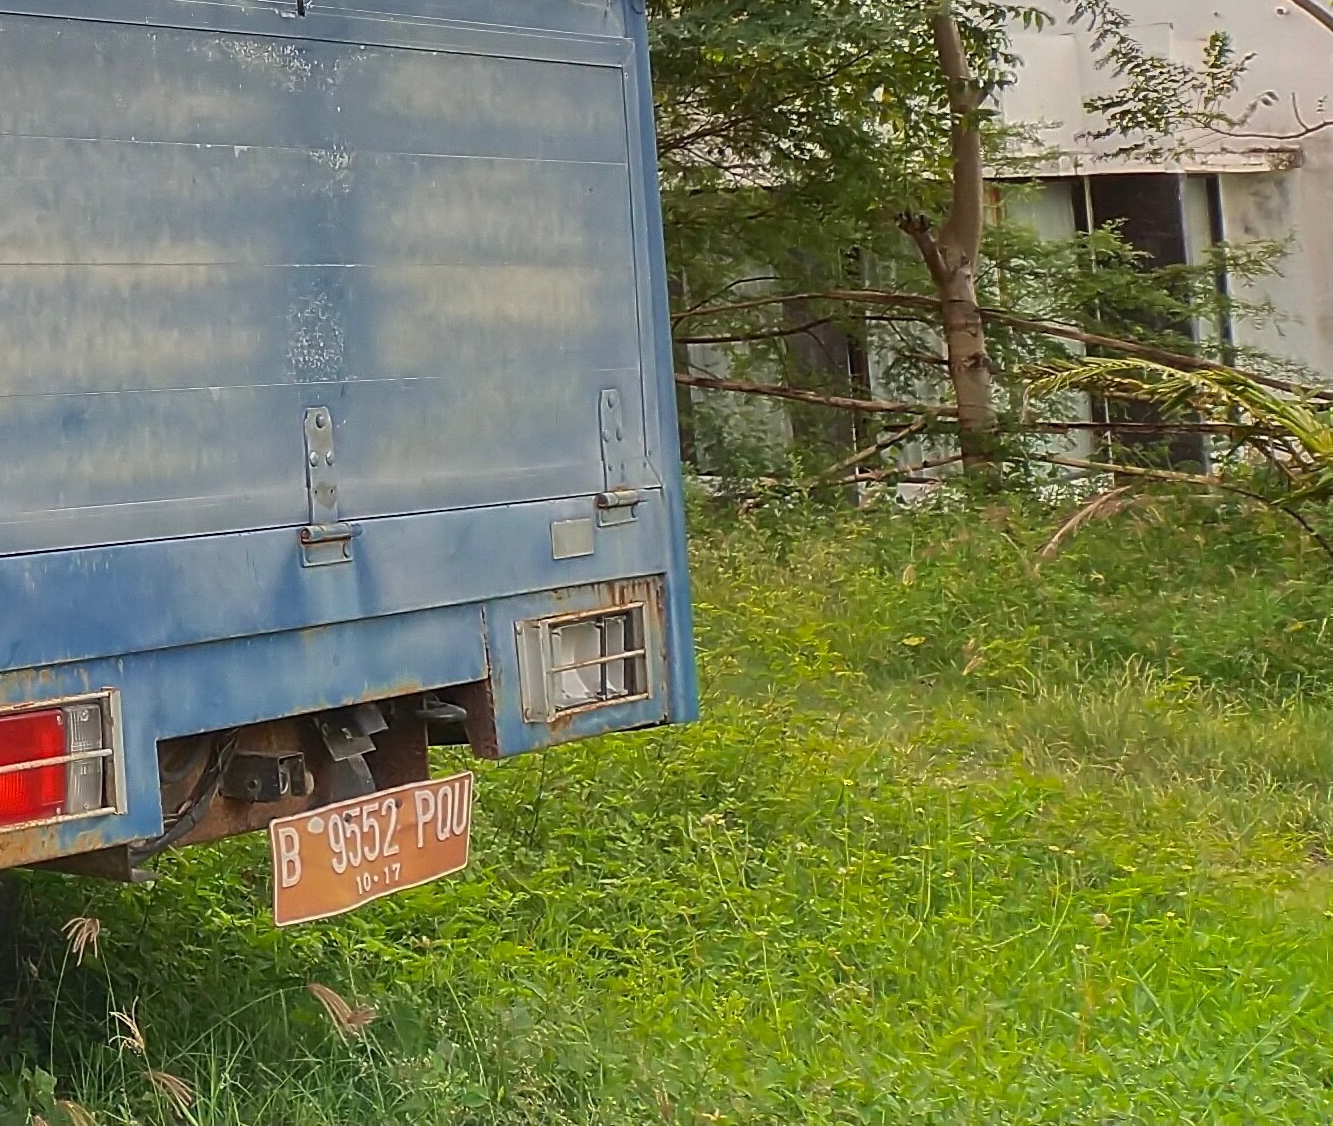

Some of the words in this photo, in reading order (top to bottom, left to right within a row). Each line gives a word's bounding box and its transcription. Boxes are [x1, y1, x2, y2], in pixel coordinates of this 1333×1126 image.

[278, 826, 302, 889] B
[327, 798, 400, 874] 9552
[414, 779, 470, 848] PQU
